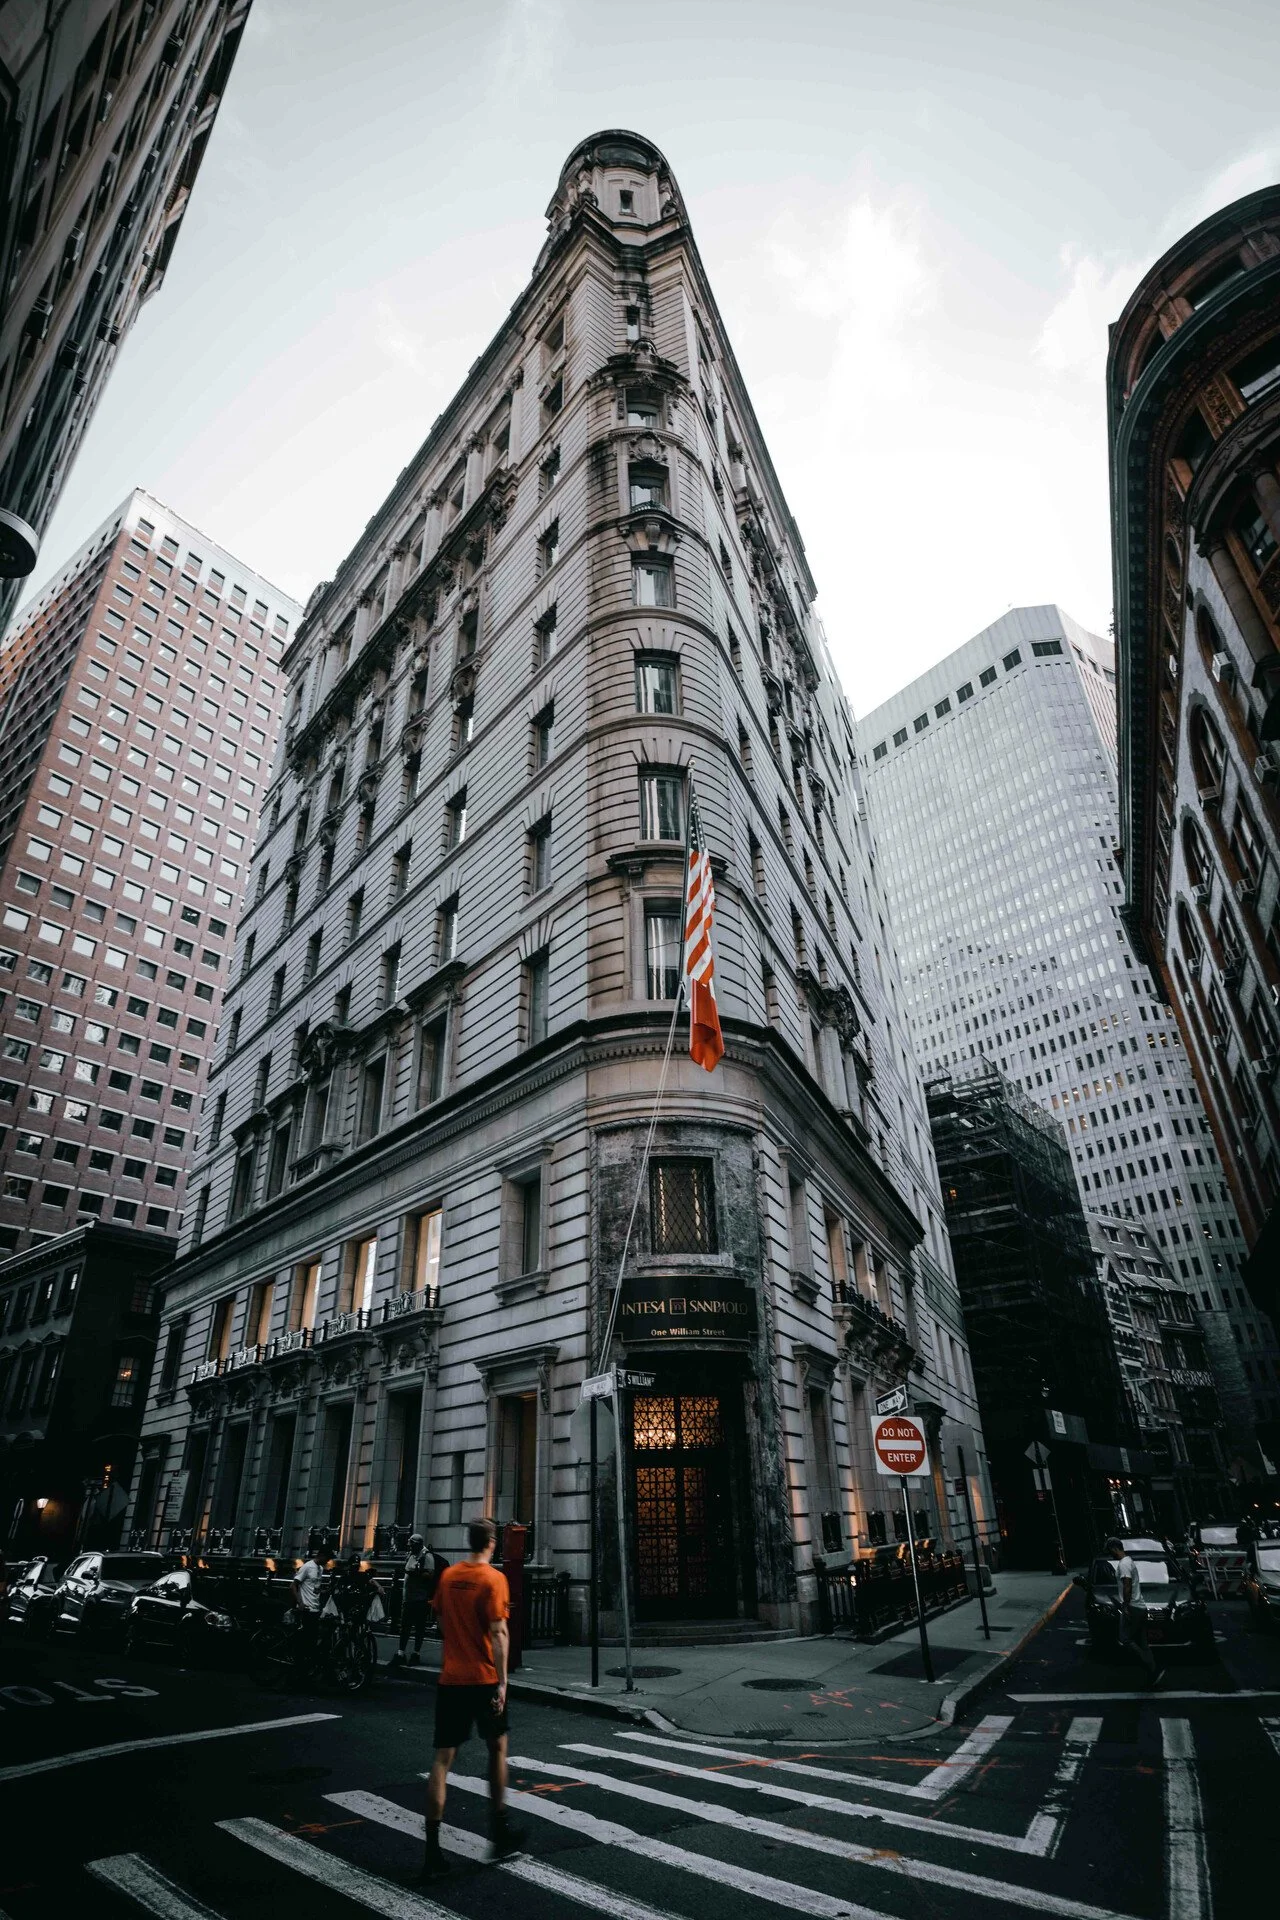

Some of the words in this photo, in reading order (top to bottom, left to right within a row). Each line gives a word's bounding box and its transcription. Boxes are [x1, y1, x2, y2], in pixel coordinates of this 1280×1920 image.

[622, 1300, 666, 1316] INTESA
[689, 1299, 749, 1315] SANPAOLO
[651, 1328, 667, 1337] One
[669, 1327, 700, 1336] William
[702, 1328, 726, 1337] Street
[627, 1374, 633, 1385] S
[632, 1374, 652, 1387] WILLIAM
[880, 1401, 890, 1412] ONE
[892, 1395, 902, 1407] WAY
[881, 1427, 895, 1437] DO
[897, 1428, 915, 1438] NOT
[887, 1452, 917, 1463] ENTER
